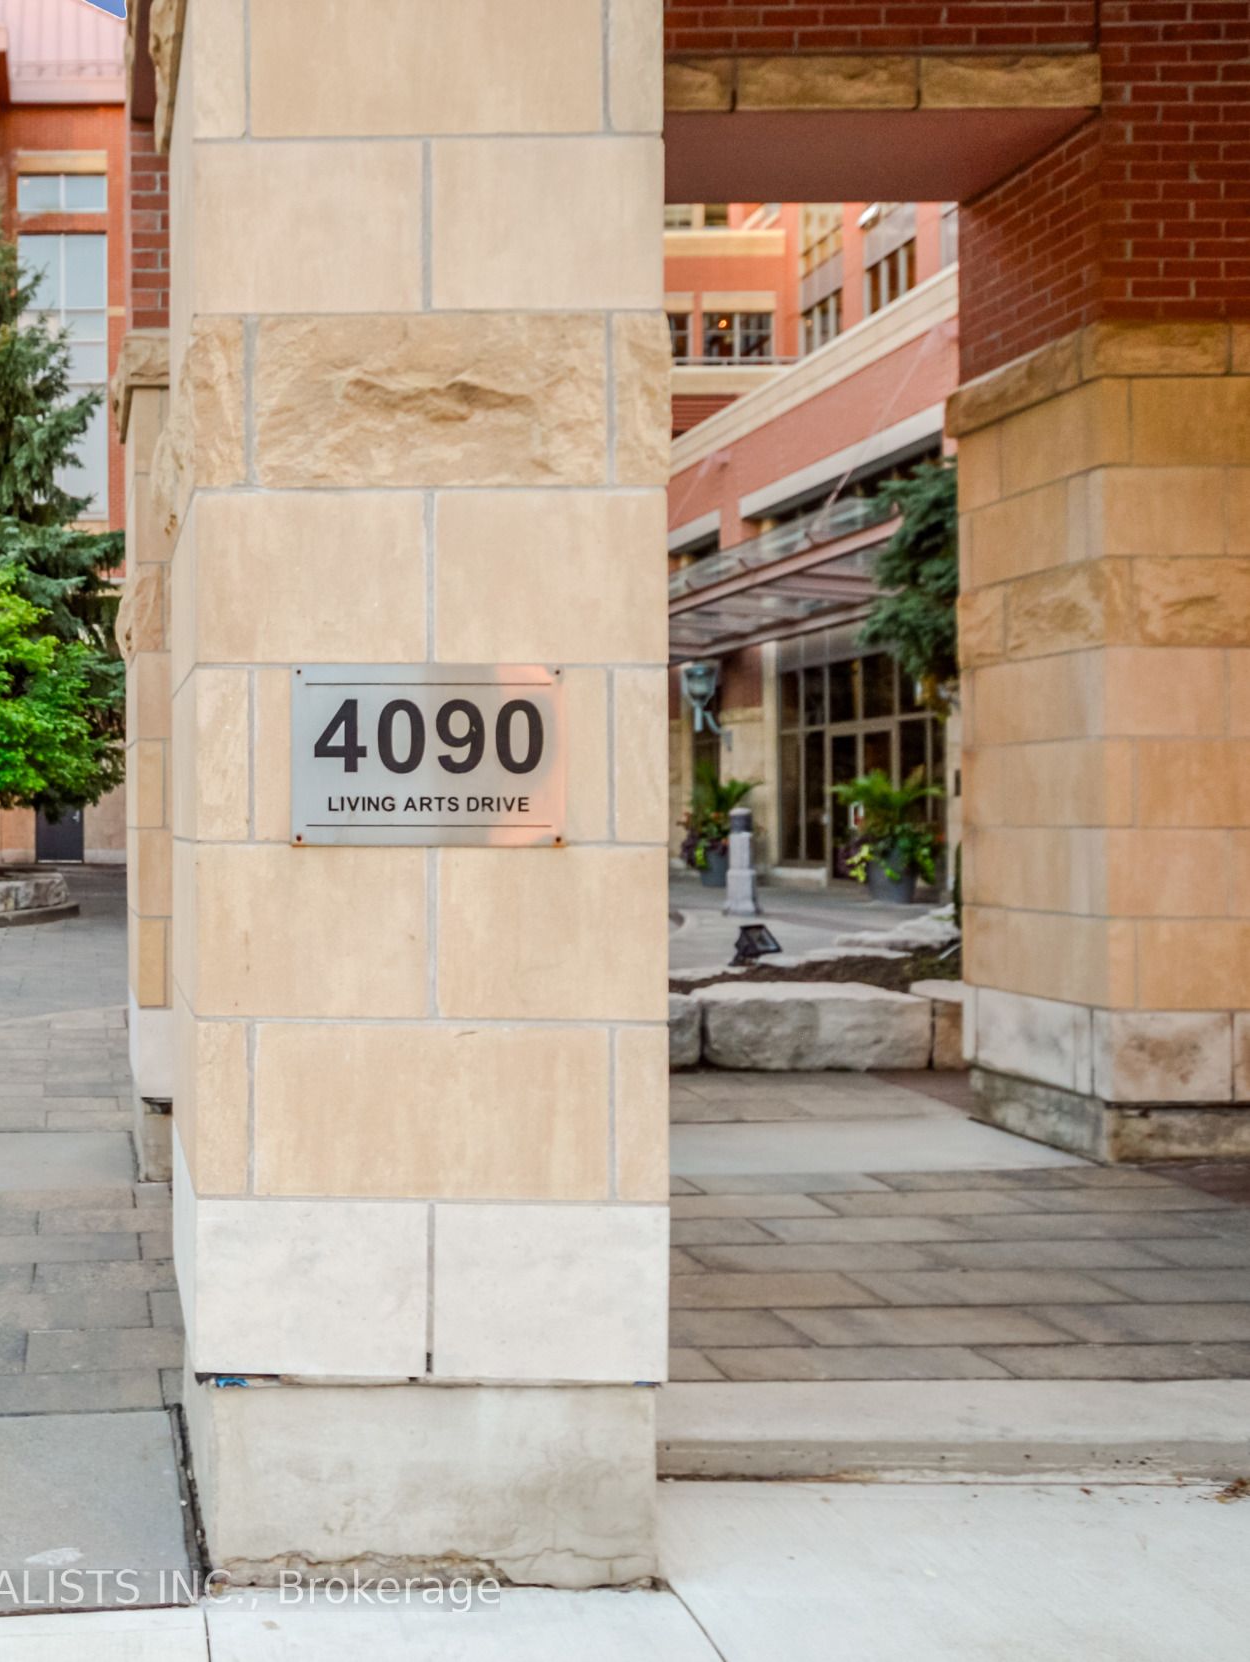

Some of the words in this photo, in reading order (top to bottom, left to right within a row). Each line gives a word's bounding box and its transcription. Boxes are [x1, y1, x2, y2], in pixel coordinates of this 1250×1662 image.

[314, 699, 544, 774] 4090
[327, 796, 396, 812] LIVING
[403, 796, 460, 812] ARTS
[466, 796, 530, 812] DRIVE
